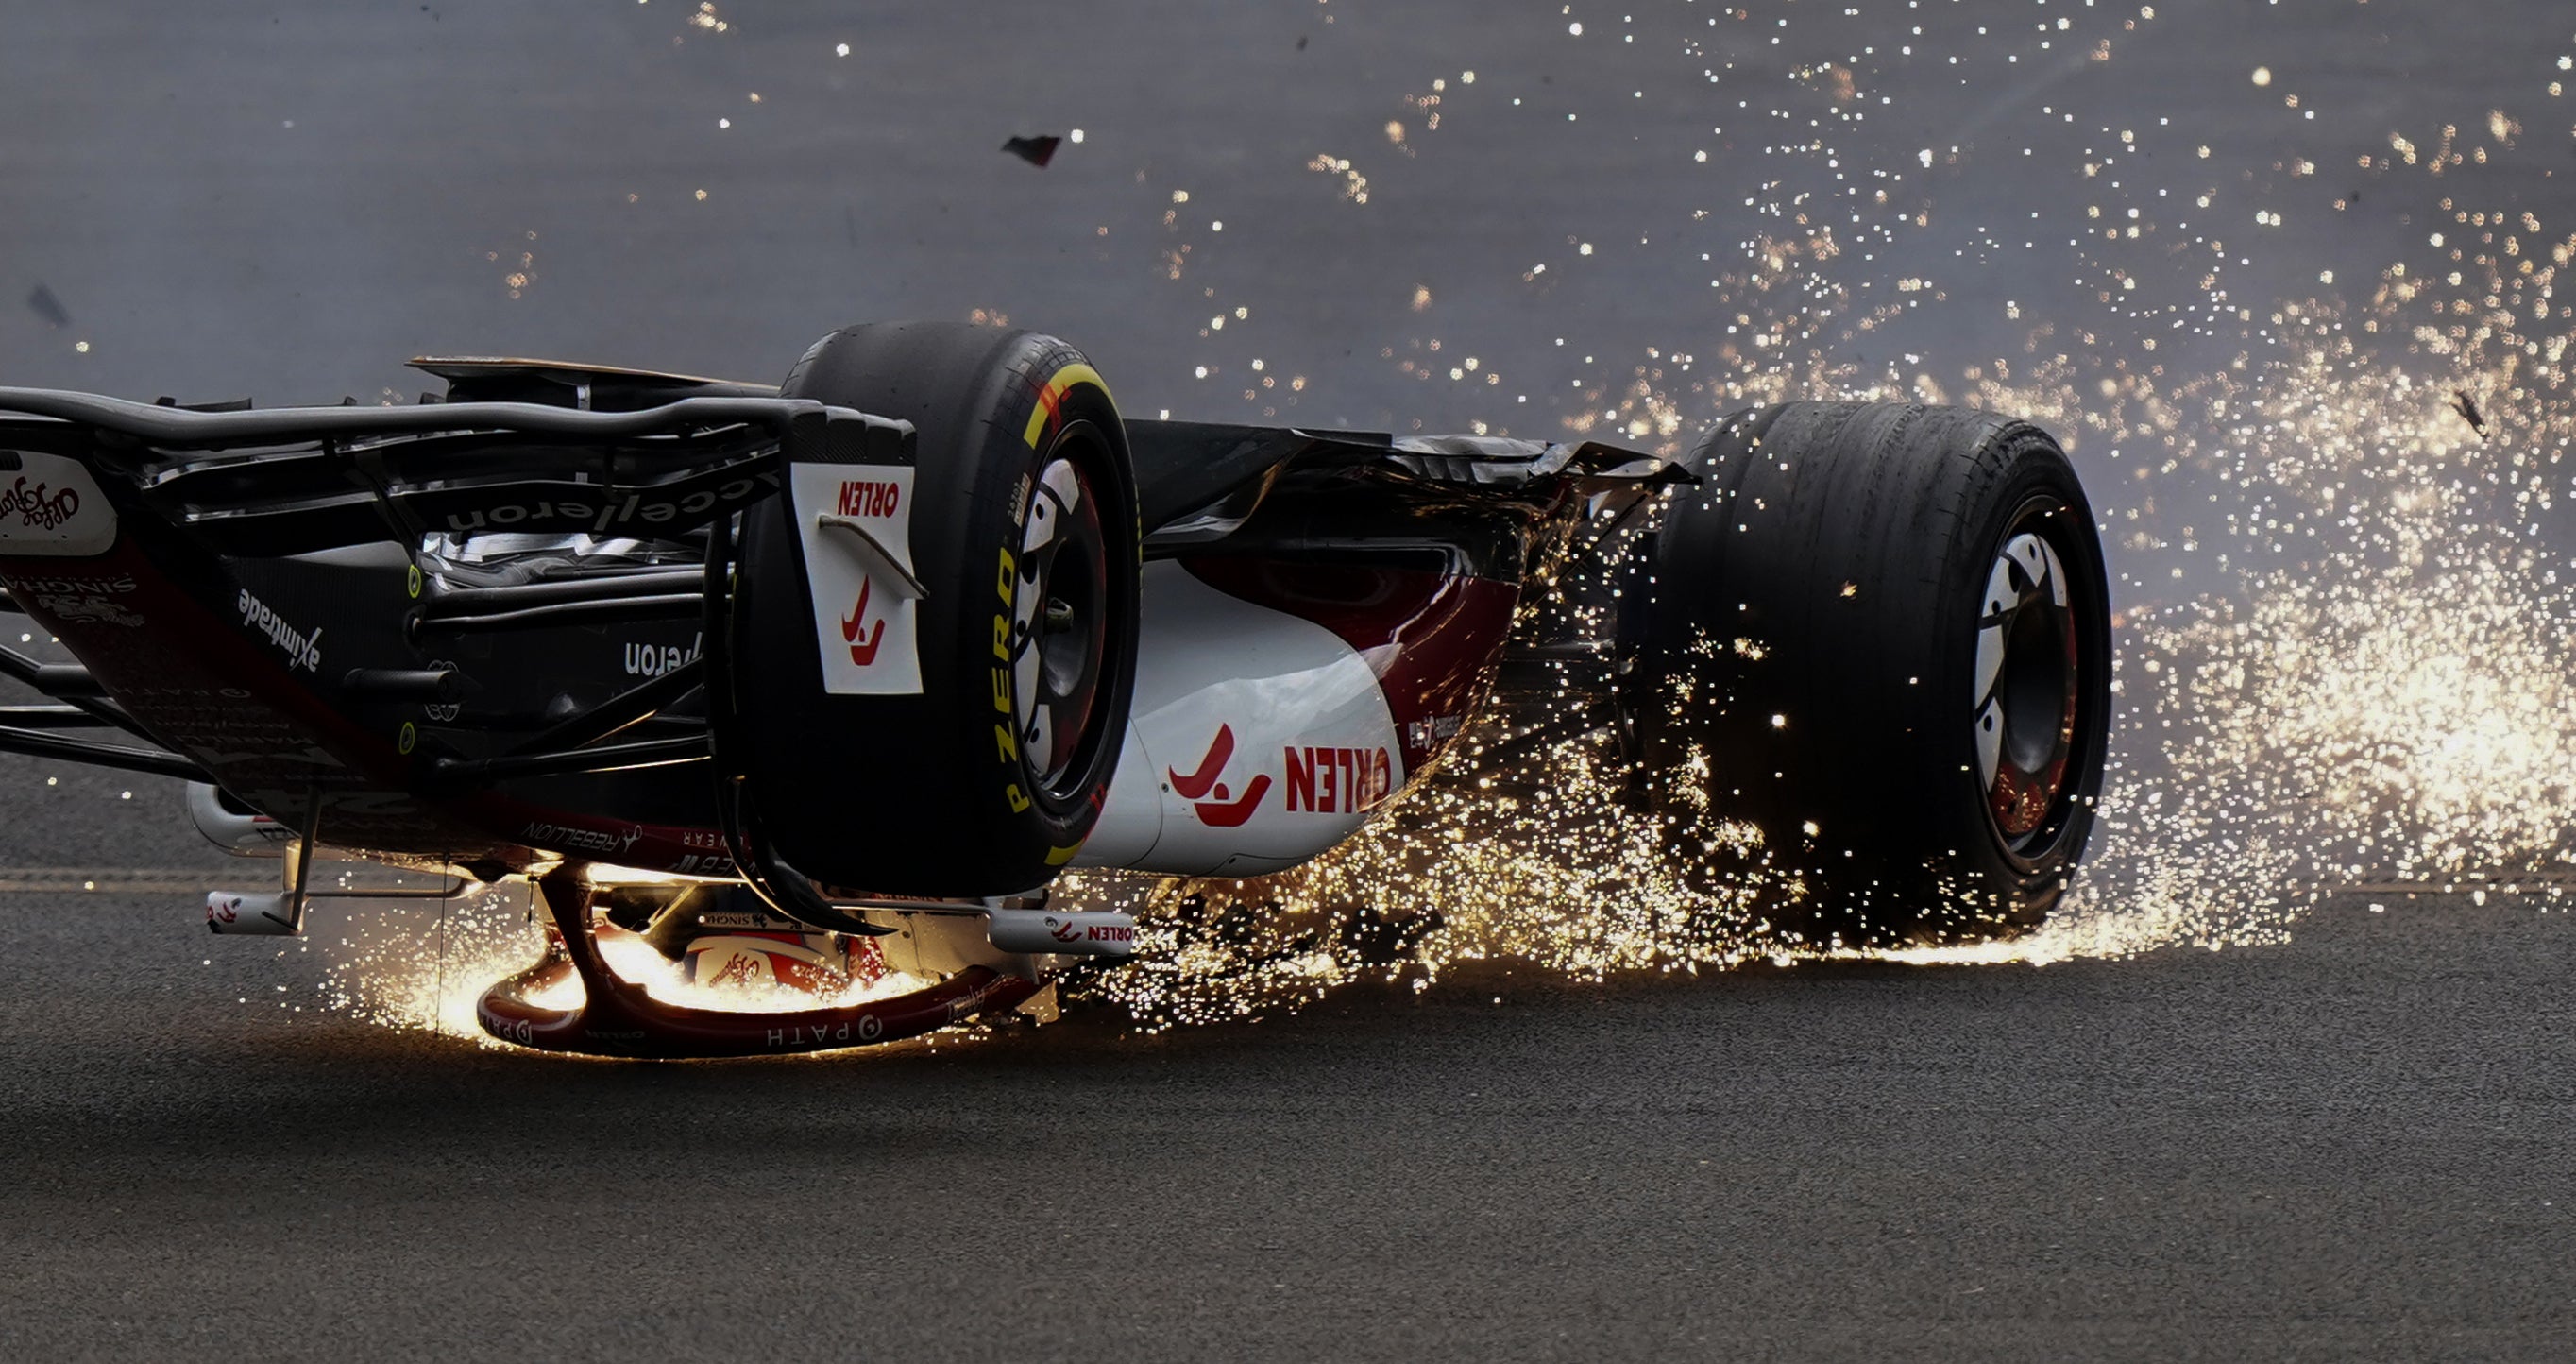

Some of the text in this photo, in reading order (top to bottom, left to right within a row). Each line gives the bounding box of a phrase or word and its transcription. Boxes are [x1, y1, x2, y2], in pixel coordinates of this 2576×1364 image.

[838, 480, 899, 518] ORLEN
[238, 588, 323, 673] aximtrade
[992, 547, 1030, 813] P ZERO
[1284, 745, 1391, 813] ORLEN
[521, 821, 620, 852] REBELLION
[1088, 926, 1132, 941] ORLEN
[767, 1022, 849, 1047] PATH
